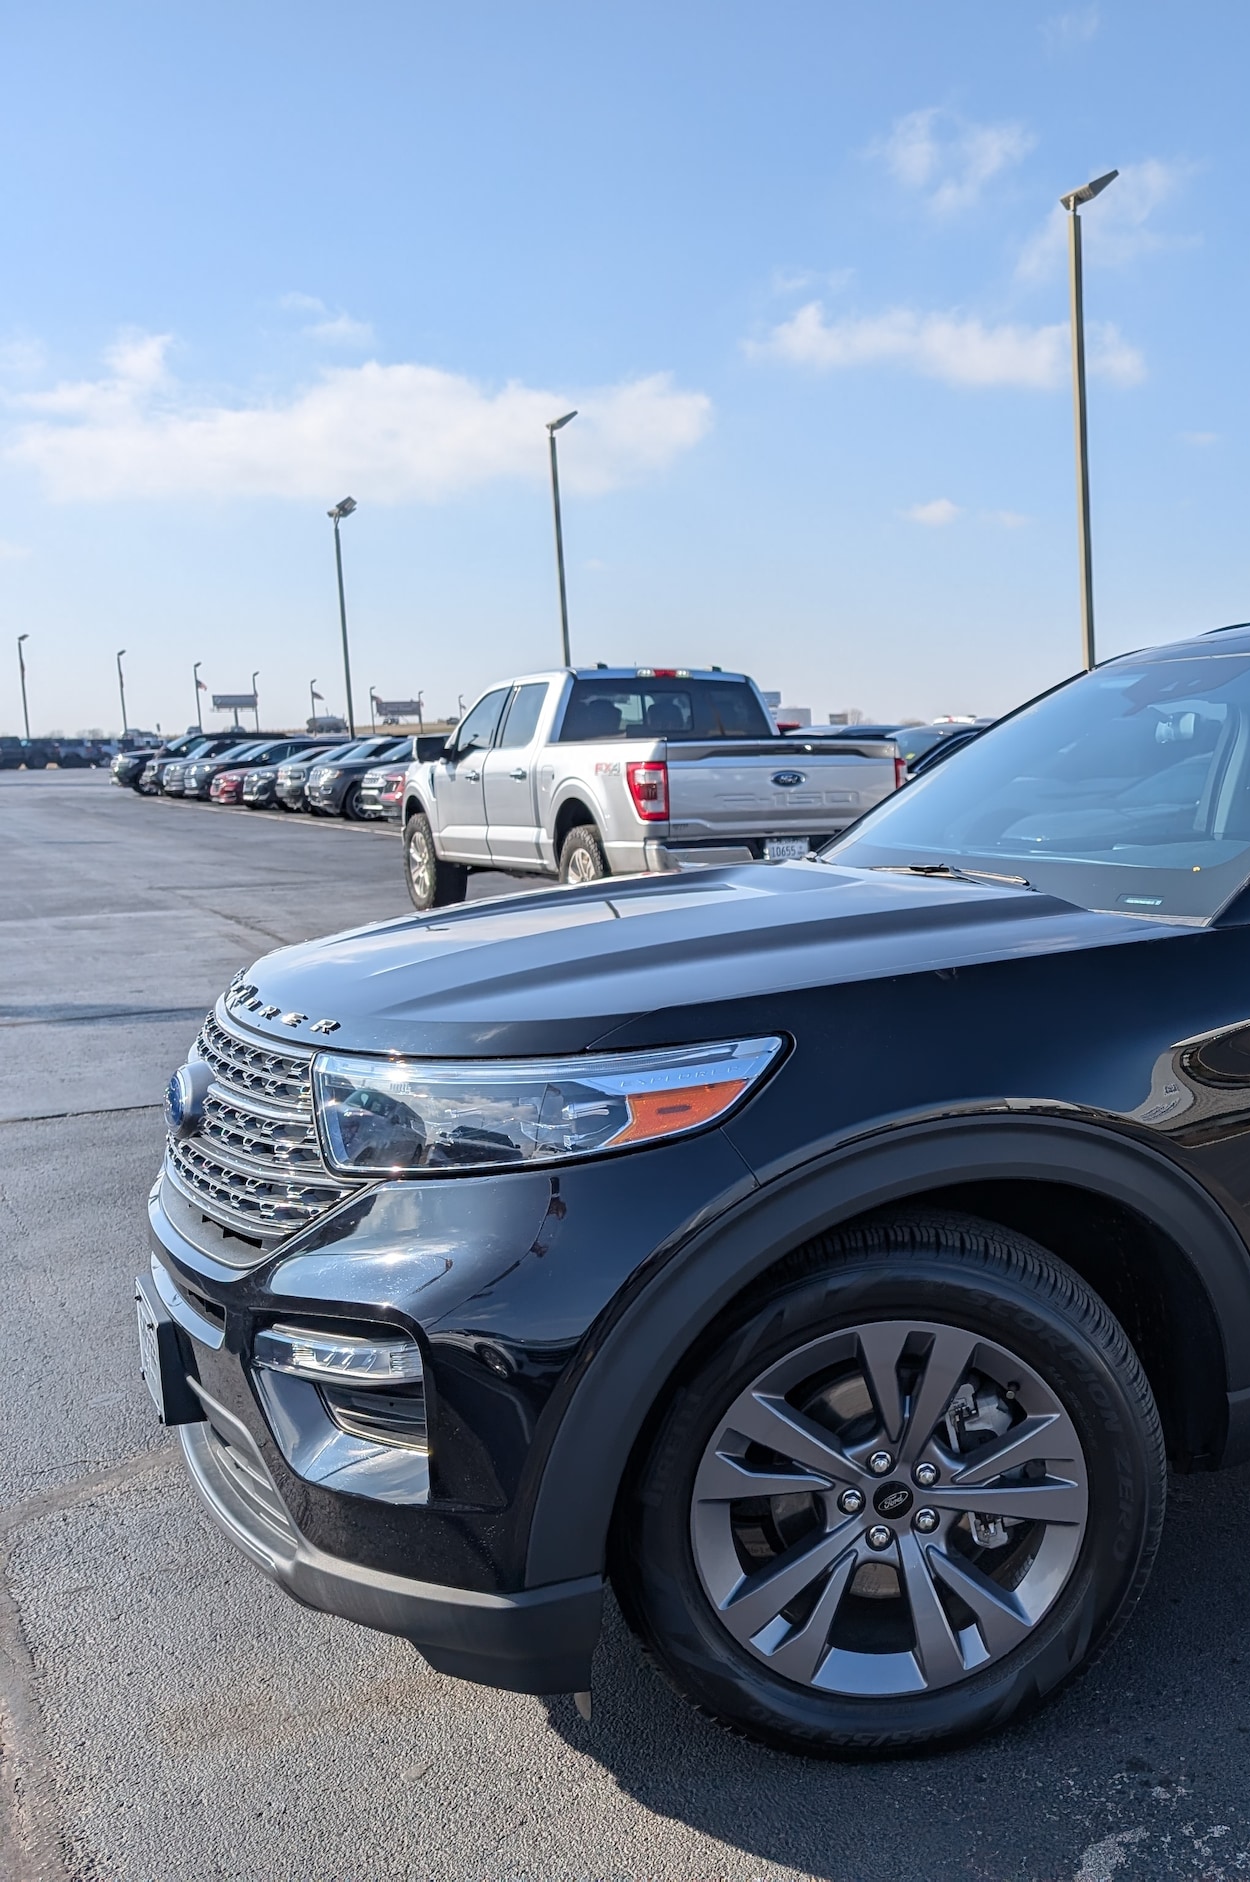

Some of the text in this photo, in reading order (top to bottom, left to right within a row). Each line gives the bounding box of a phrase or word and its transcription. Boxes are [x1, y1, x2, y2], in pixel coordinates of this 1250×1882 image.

[594, 762, 621, 776] FX4
[713, 790, 861, 808] F-150
[961, 1288, 1123, 1433] SCORPION
[1112, 1445, 1136, 1562] ZERO
